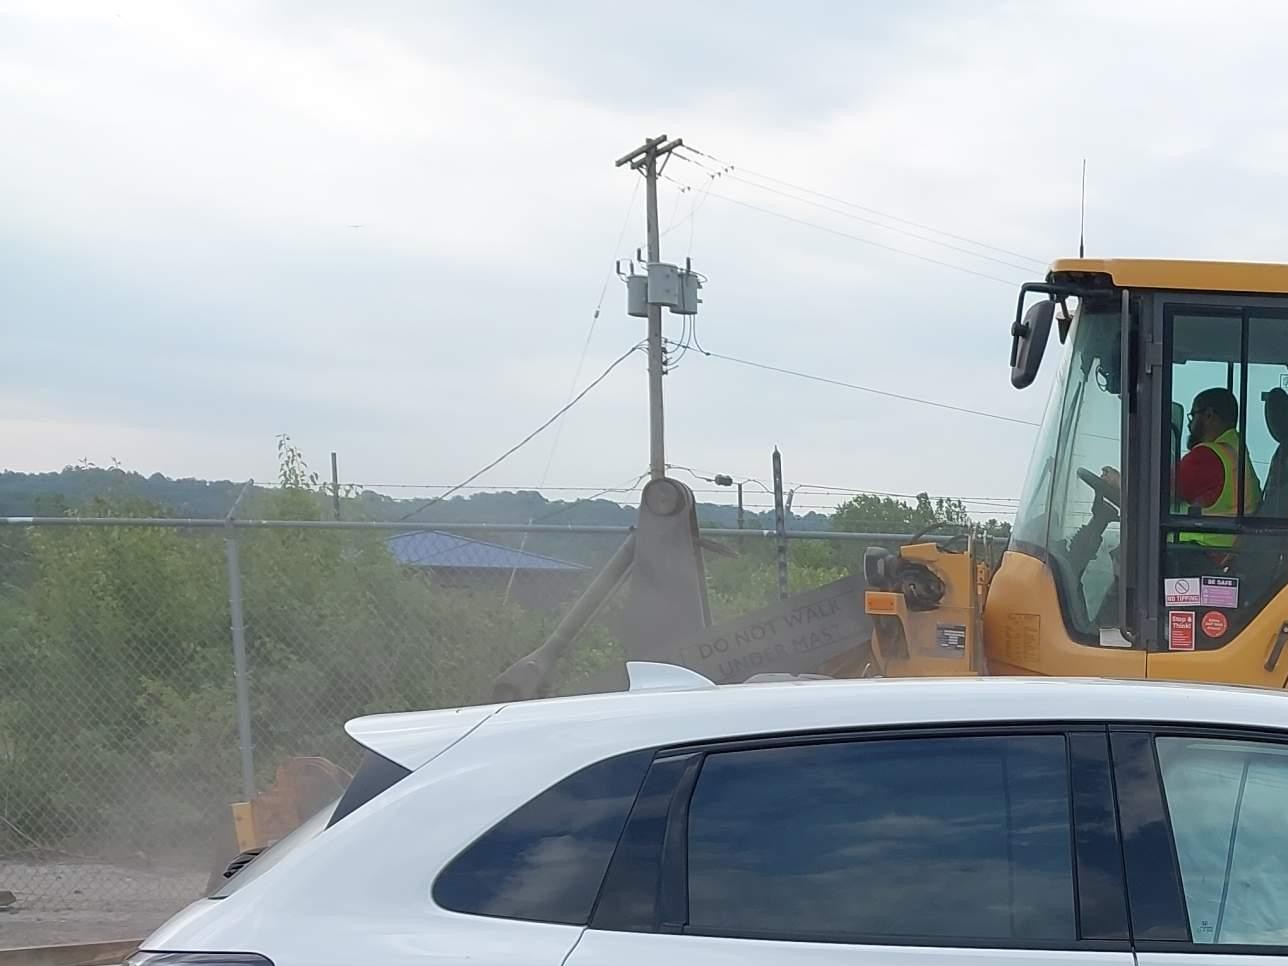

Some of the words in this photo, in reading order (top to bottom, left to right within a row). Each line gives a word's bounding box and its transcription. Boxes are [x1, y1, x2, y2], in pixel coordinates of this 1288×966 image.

[699, 638, 730, 660] DO
[735, 620, 777, 648] NOT
[783, 600, 841, 628] WALK
[718, 643, 790, 677] UNDER
